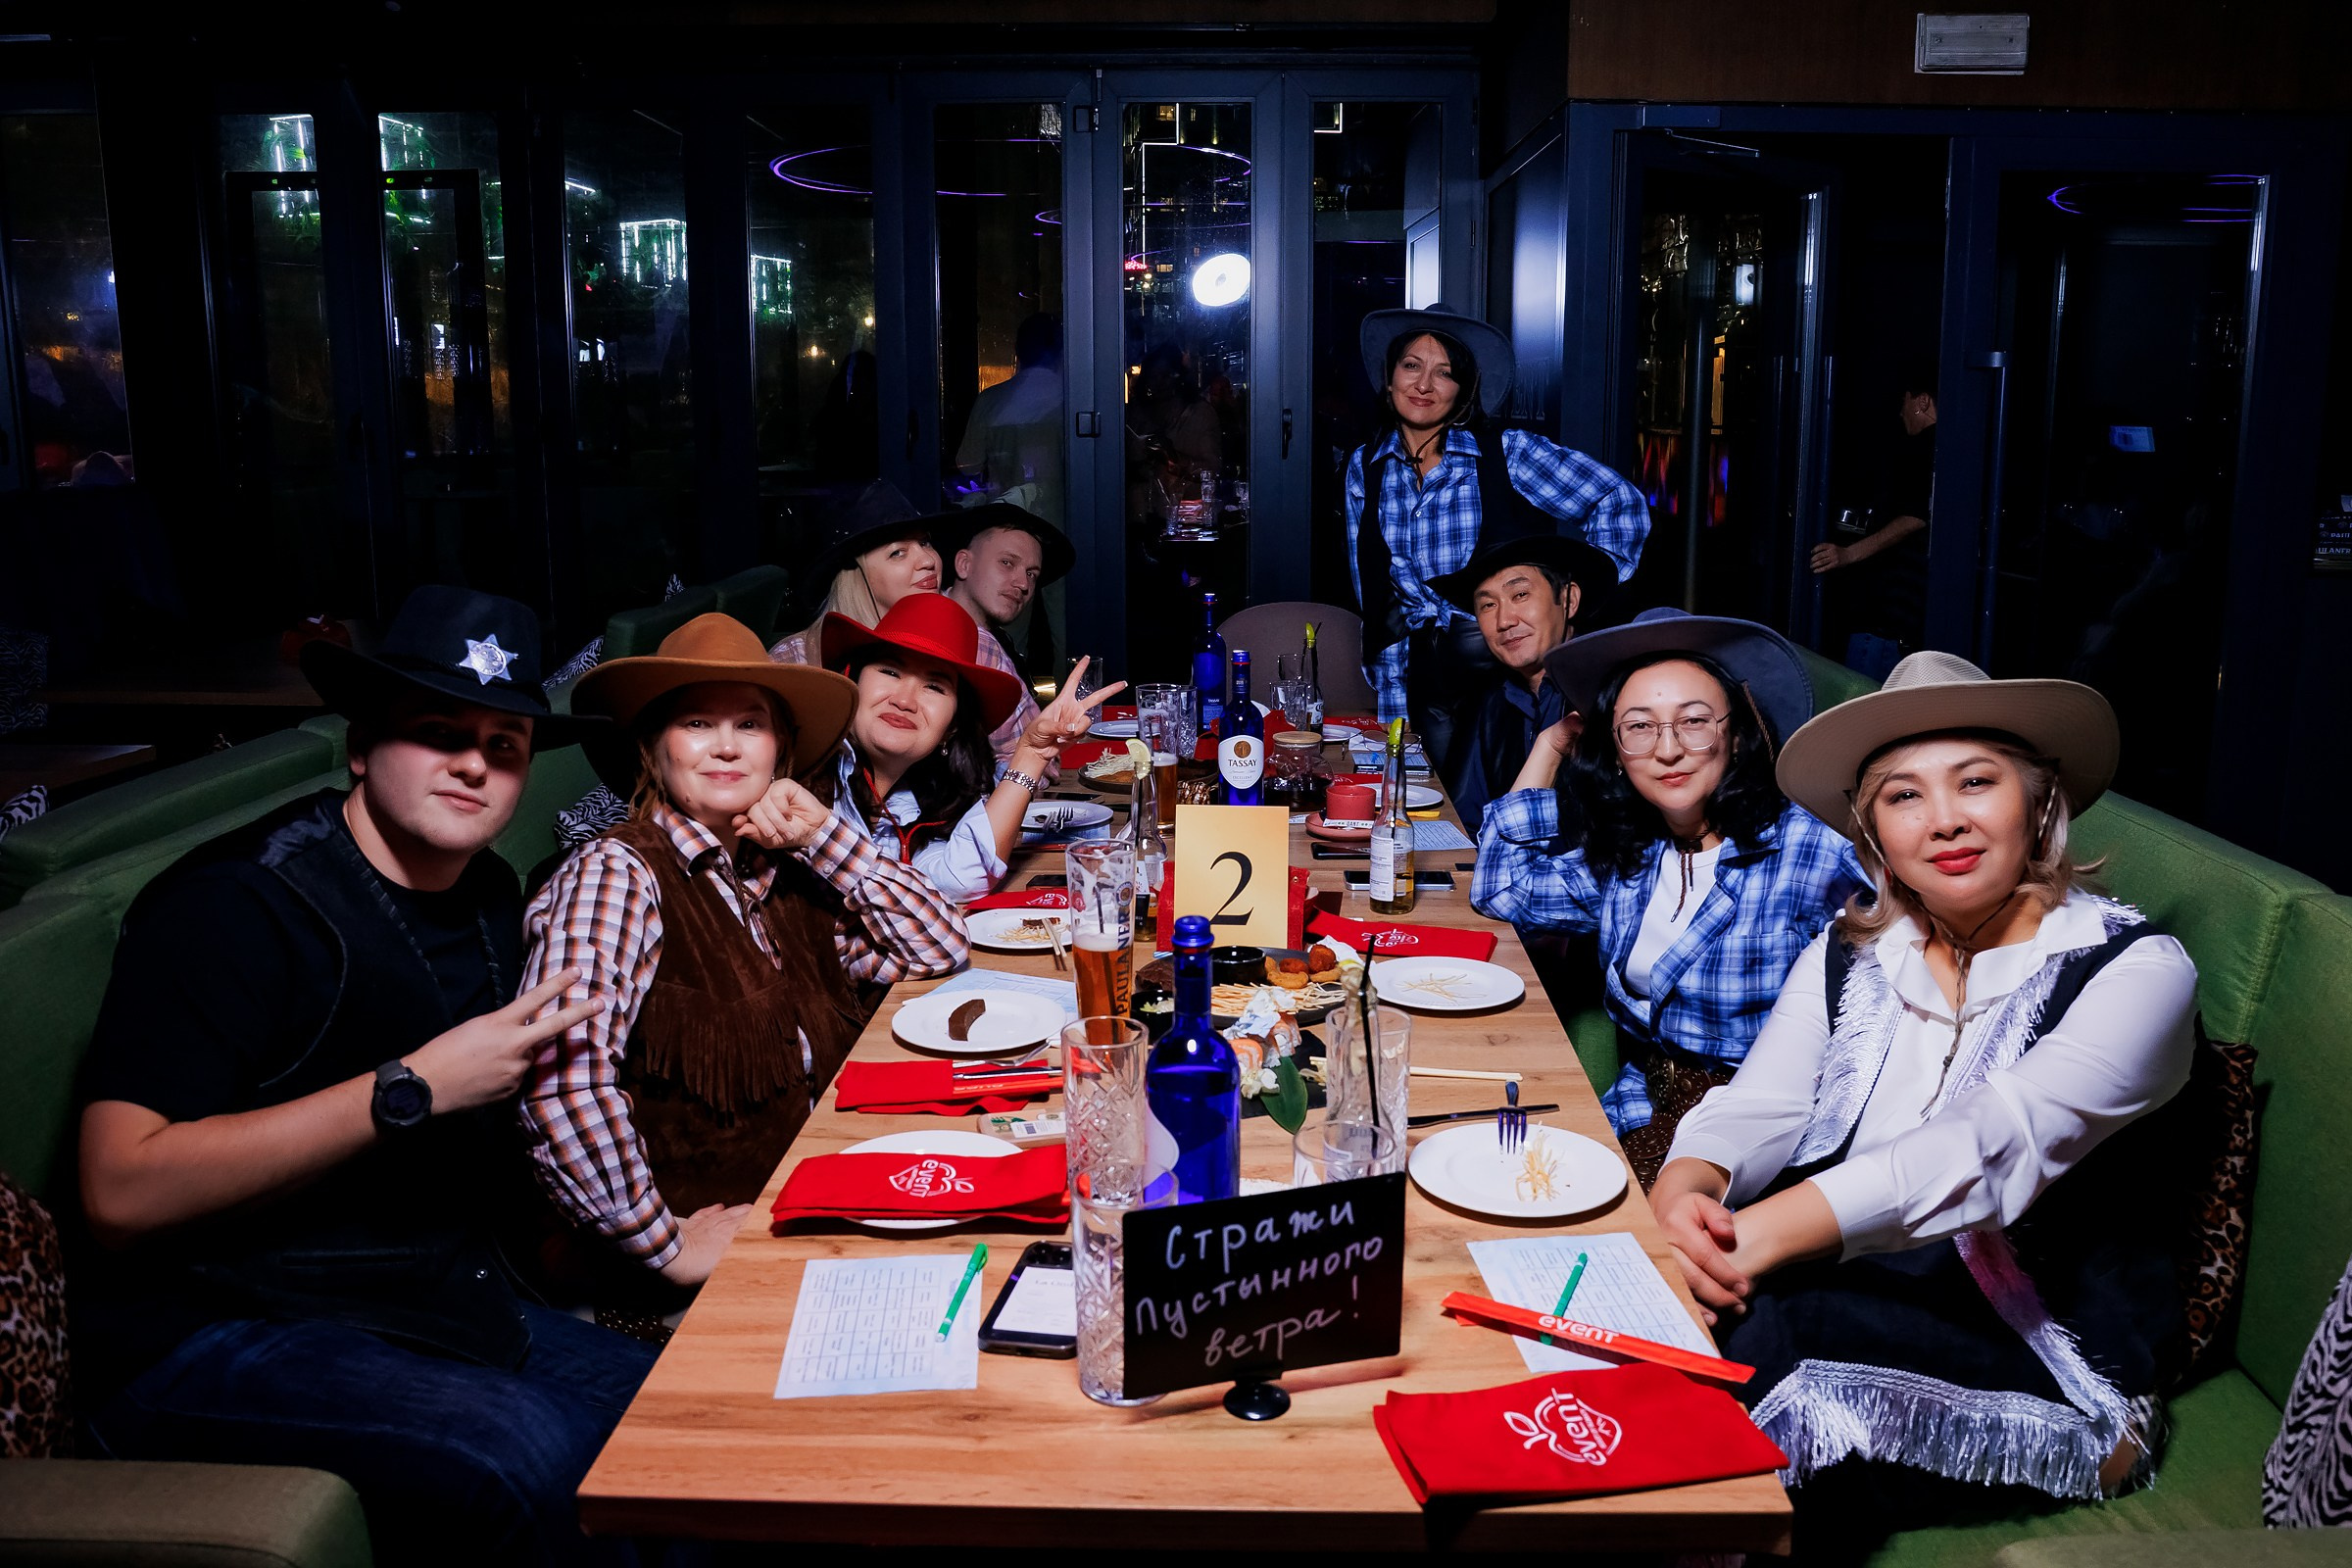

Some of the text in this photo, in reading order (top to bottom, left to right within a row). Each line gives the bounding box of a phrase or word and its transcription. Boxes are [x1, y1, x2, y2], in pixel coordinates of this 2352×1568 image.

[1209, 851, 1254, 926] 2
[1116, 908, 1130, 1016] PAULANER
[1166, 1200, 1354, 1274] Стражи
